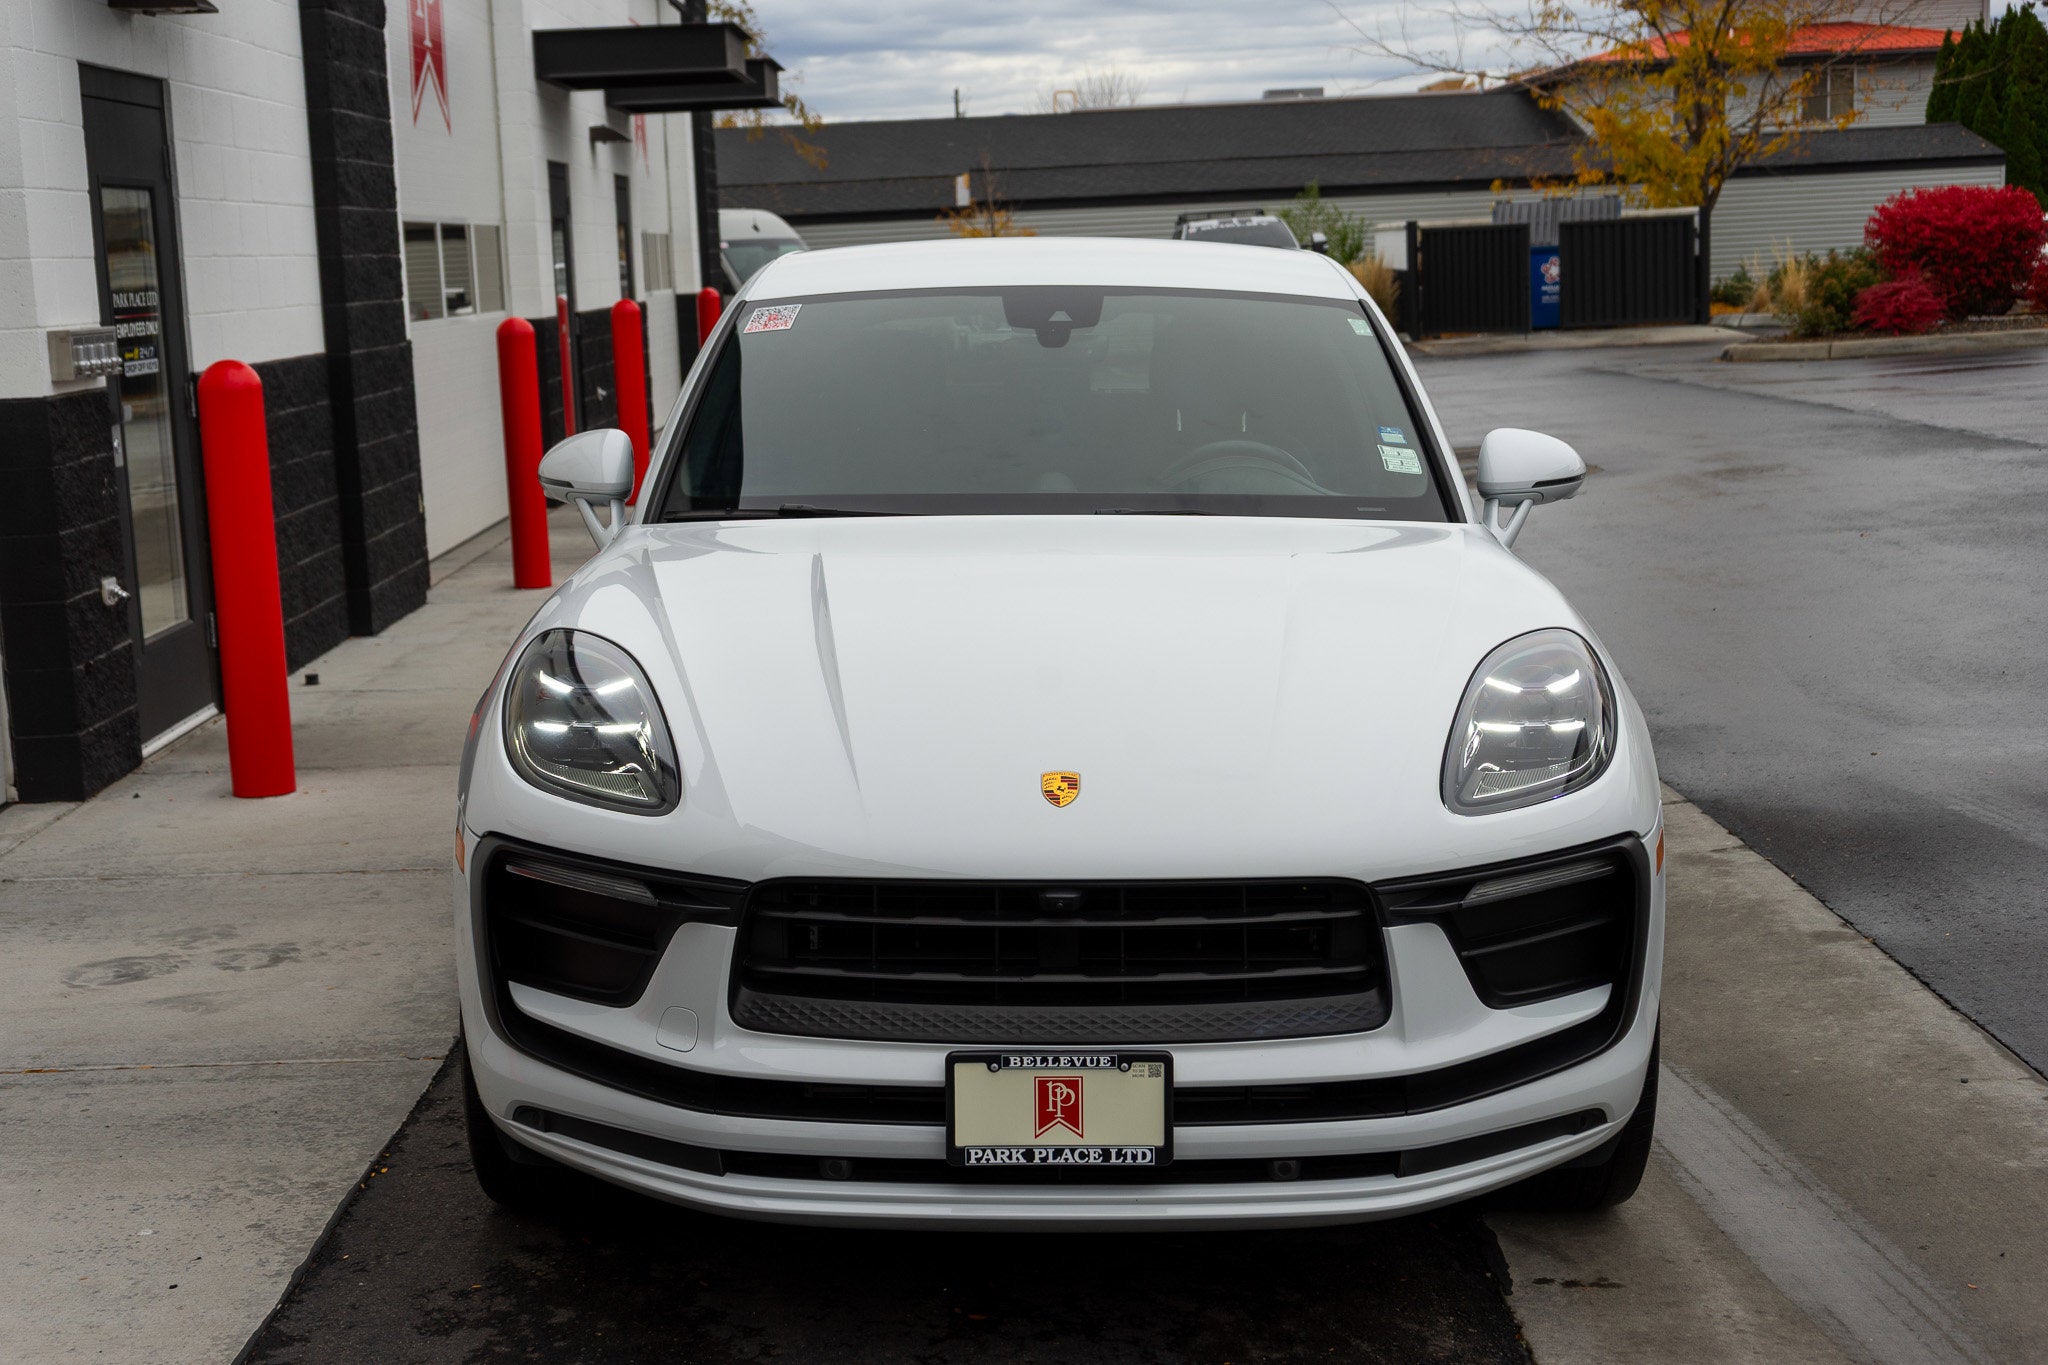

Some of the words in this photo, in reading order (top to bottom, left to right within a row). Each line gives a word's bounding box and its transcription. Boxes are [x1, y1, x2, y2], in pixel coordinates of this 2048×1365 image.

[112, 293, 129, 308] PARK
[129, 292, 146, 307] PLACE
[146, 291, 158, 306] LTD
[116, 321, 146, 339] EMPLOYEES
[146, 321, 159, 335] ONLY
[1009, 1056, 1111, 1067] BELLEVUE
[968, 1149, 1027, 1164] PARK
[1032, 1149, 1103, 1164] PLACE
[1109, 1149, 1152, 1164] LTD
